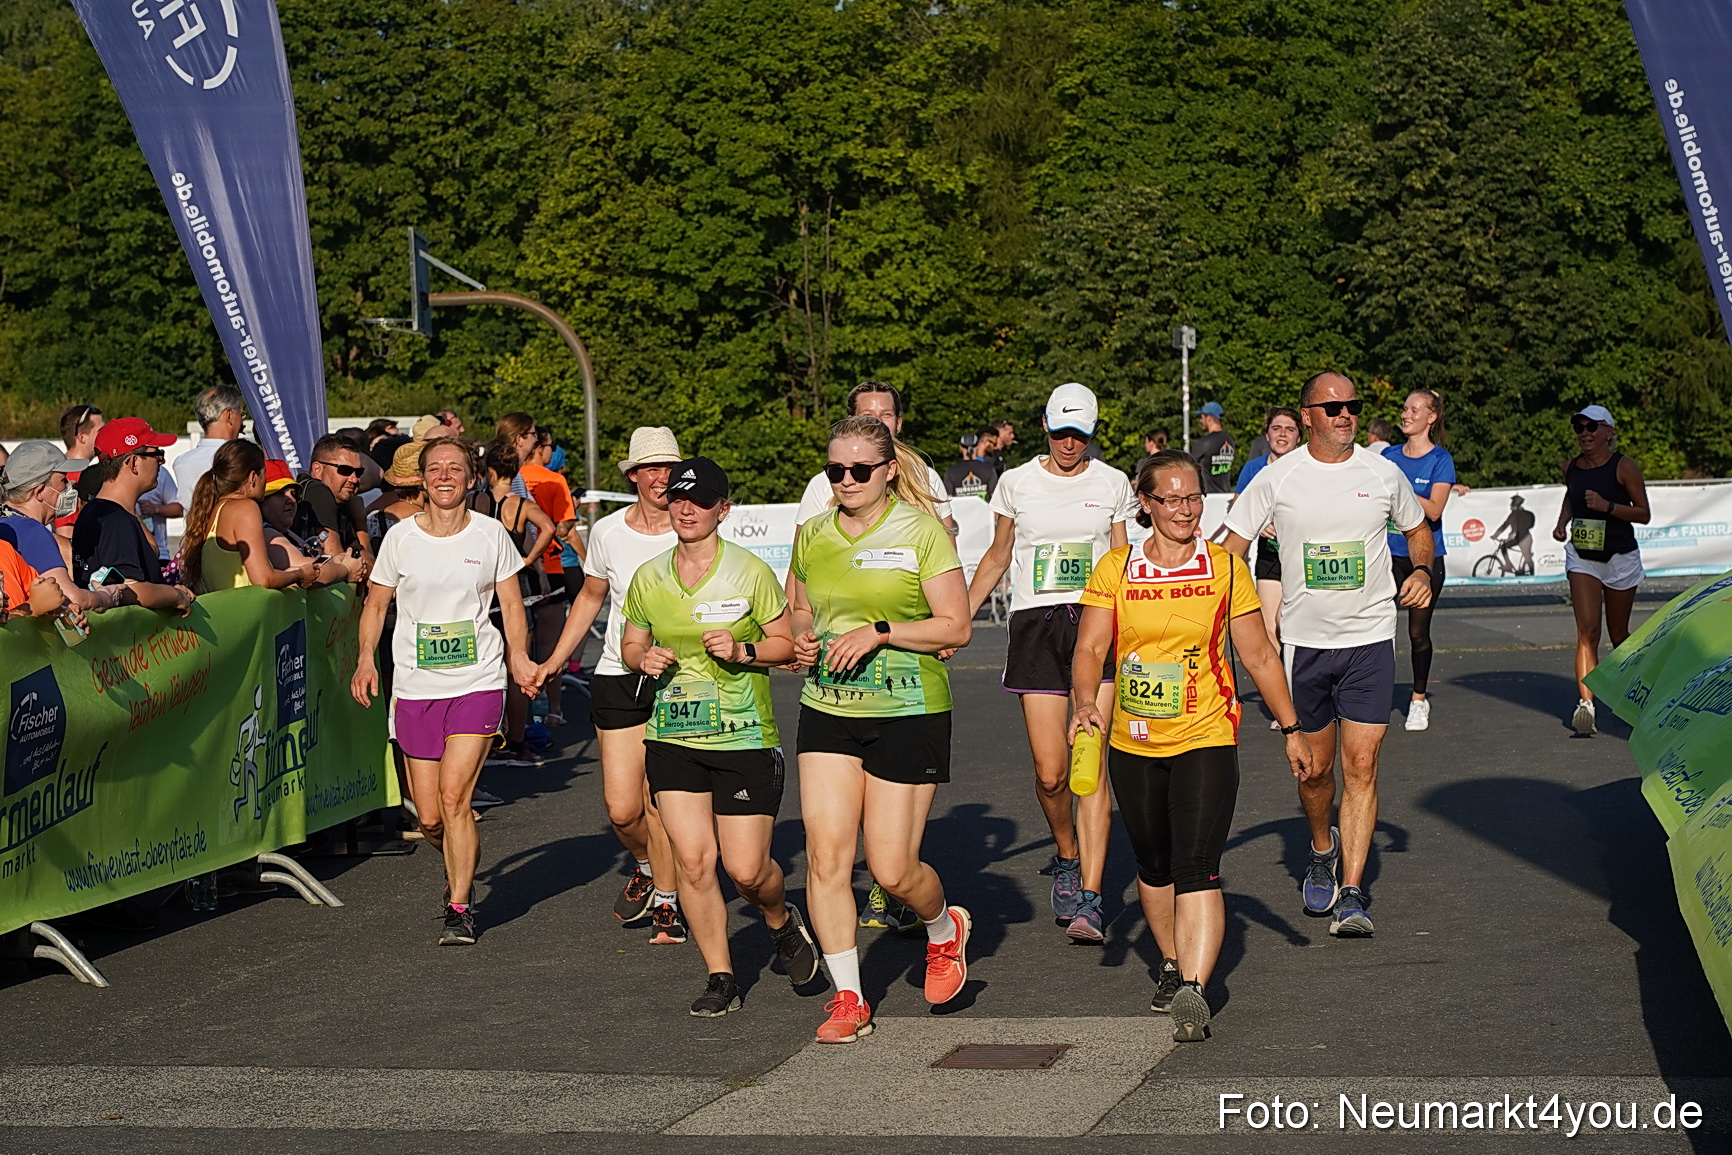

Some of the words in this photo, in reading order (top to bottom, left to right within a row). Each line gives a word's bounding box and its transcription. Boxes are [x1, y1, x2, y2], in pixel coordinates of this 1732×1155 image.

[733, 525, 768, 538] NOW
[1574, 529, 1595, 540] 495
[1668, 527, 1679, 537] &
[1054, 559, 1080, 574] 05
[1319, 558, 1349, 574] 101
[1126, 589, 1164, 601] MAX
[1170, 584, 1216, 599] BÖGL
[430, 638, 461, 654] 102
[467, 637, 475, 659] 2022
[1129, 679, 1164, 699] 824
[669, 701, 701, 719] 947
[709, 702, 717, 727] 2022
[18, 705, 59, 733] Fischer
[685, 719, 710, 727] Jessica
[3, 842, 36, 878] markt
